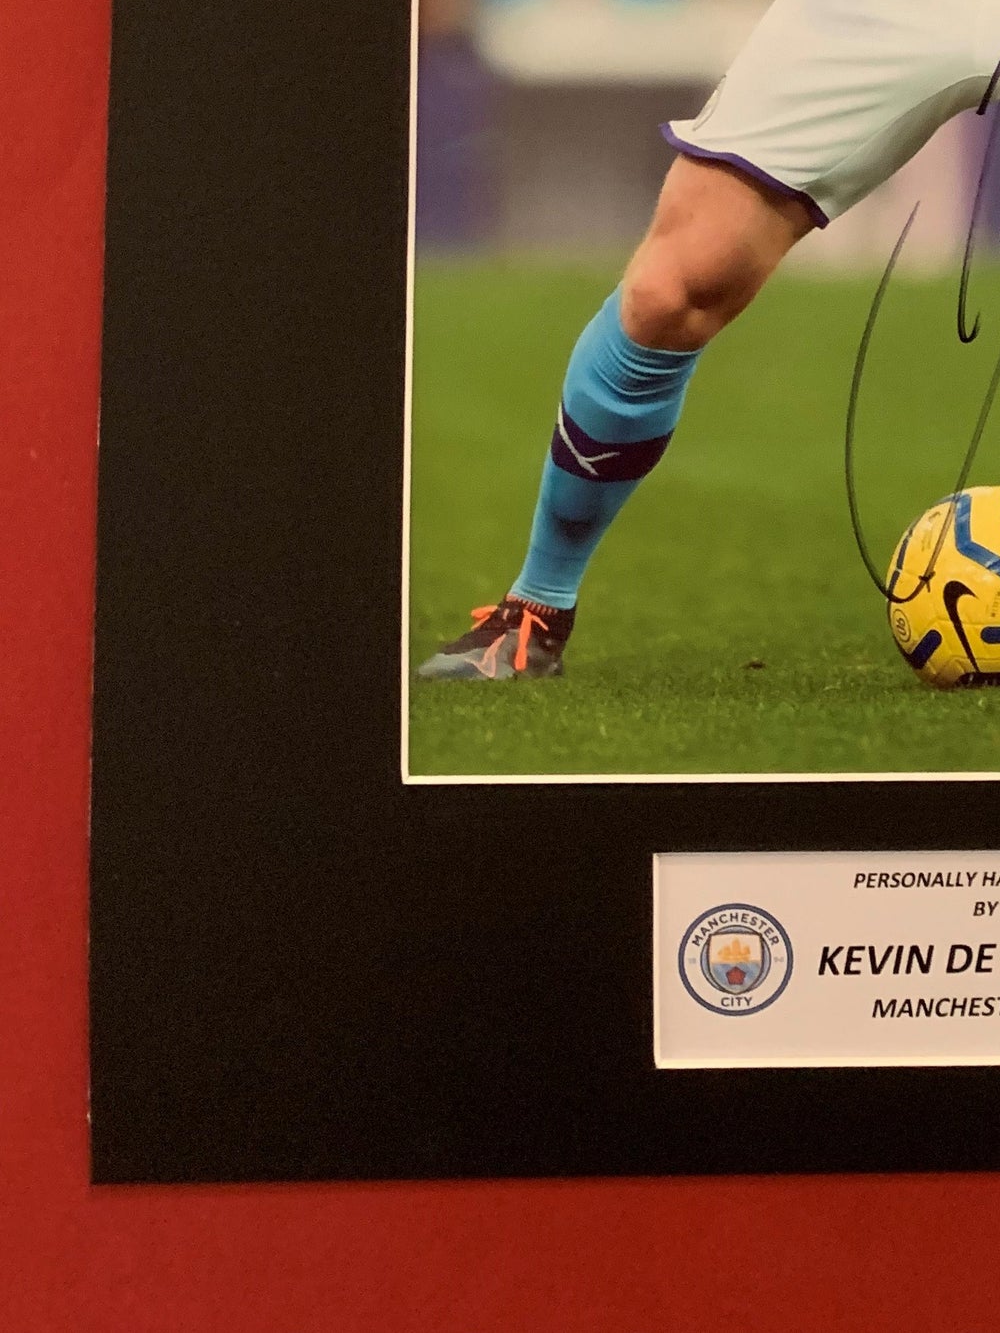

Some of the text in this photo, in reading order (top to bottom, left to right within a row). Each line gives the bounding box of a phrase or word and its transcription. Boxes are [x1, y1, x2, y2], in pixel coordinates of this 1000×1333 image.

[853, 871, 978, 889] PERSONALLY
[973, 900, 999, 917] BY
[691, 912, 780, 947] MANCHESTER
[818, 944, 934, 976] KEVIN
[946, 943, 997, 974] DE
[720, 996, 752, 1008] CITY
